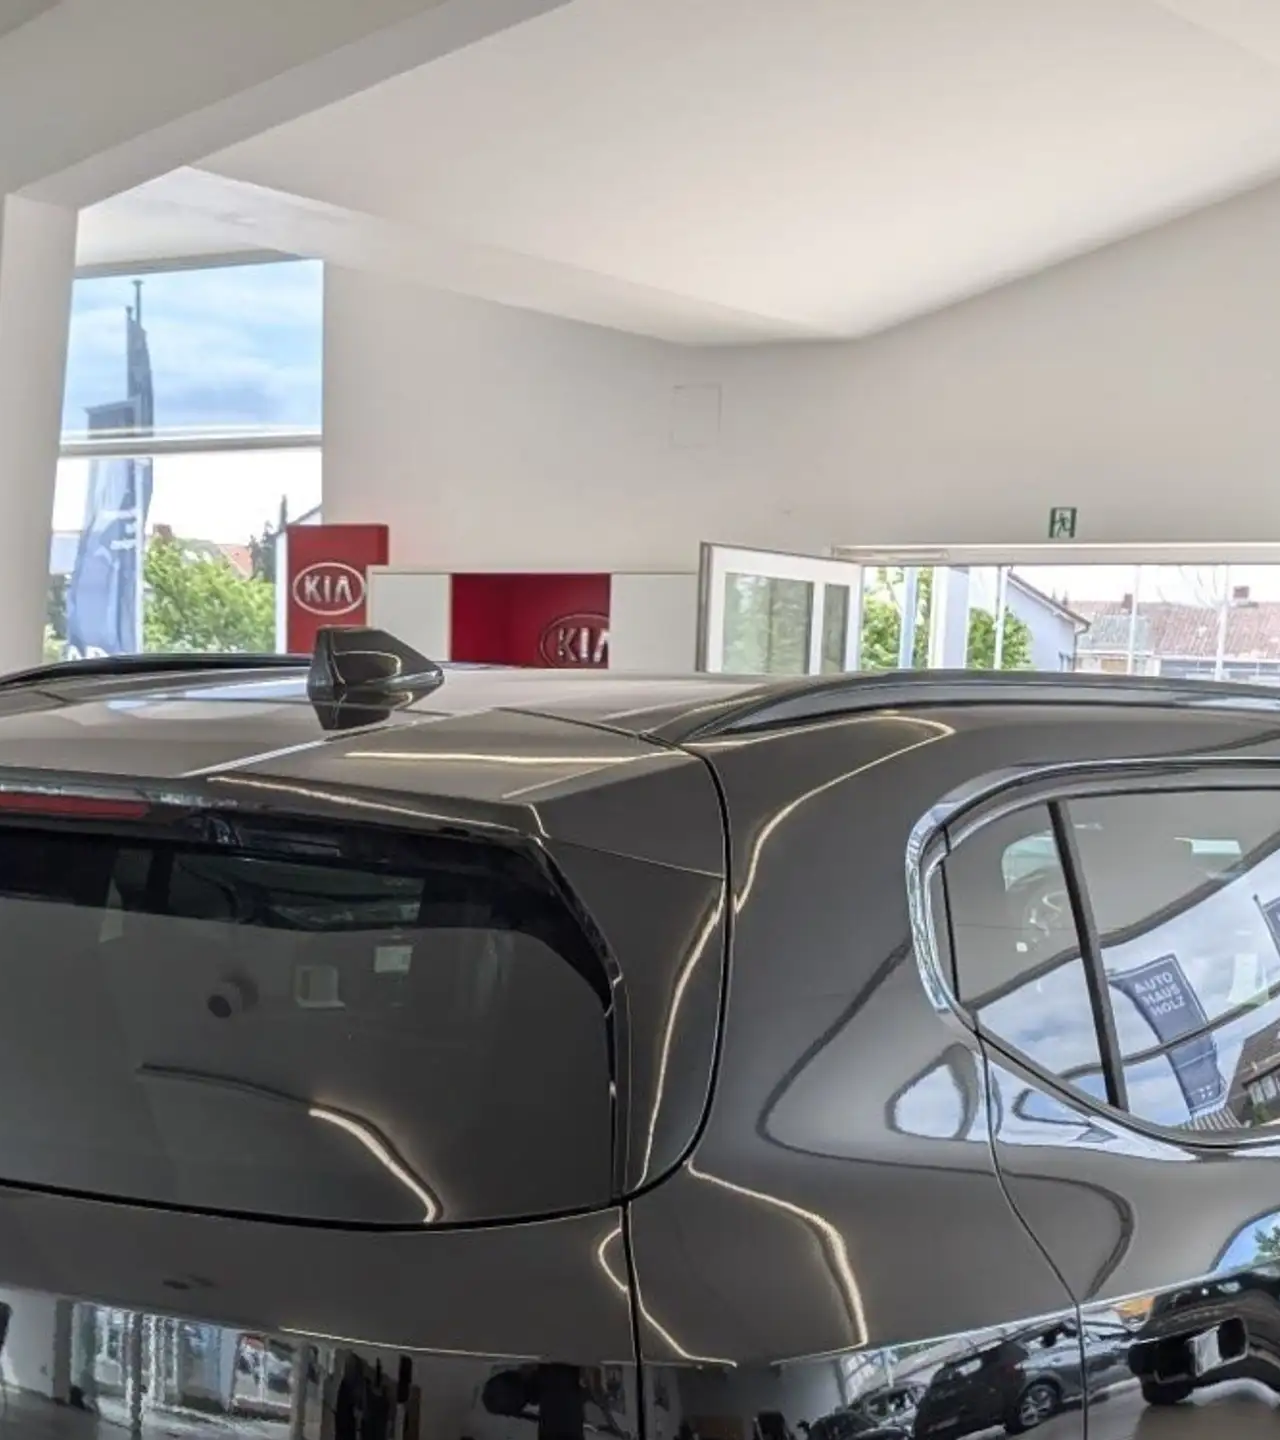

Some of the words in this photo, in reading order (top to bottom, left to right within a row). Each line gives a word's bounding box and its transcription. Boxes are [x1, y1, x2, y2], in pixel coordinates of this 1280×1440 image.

[304, 575, 353, 603] KIA
[1134, 971, 1174, 994] AUTO
[1142, 983, 1181, 1004] HAUS
[1149, 995, 1186, 1017] HOLZ
